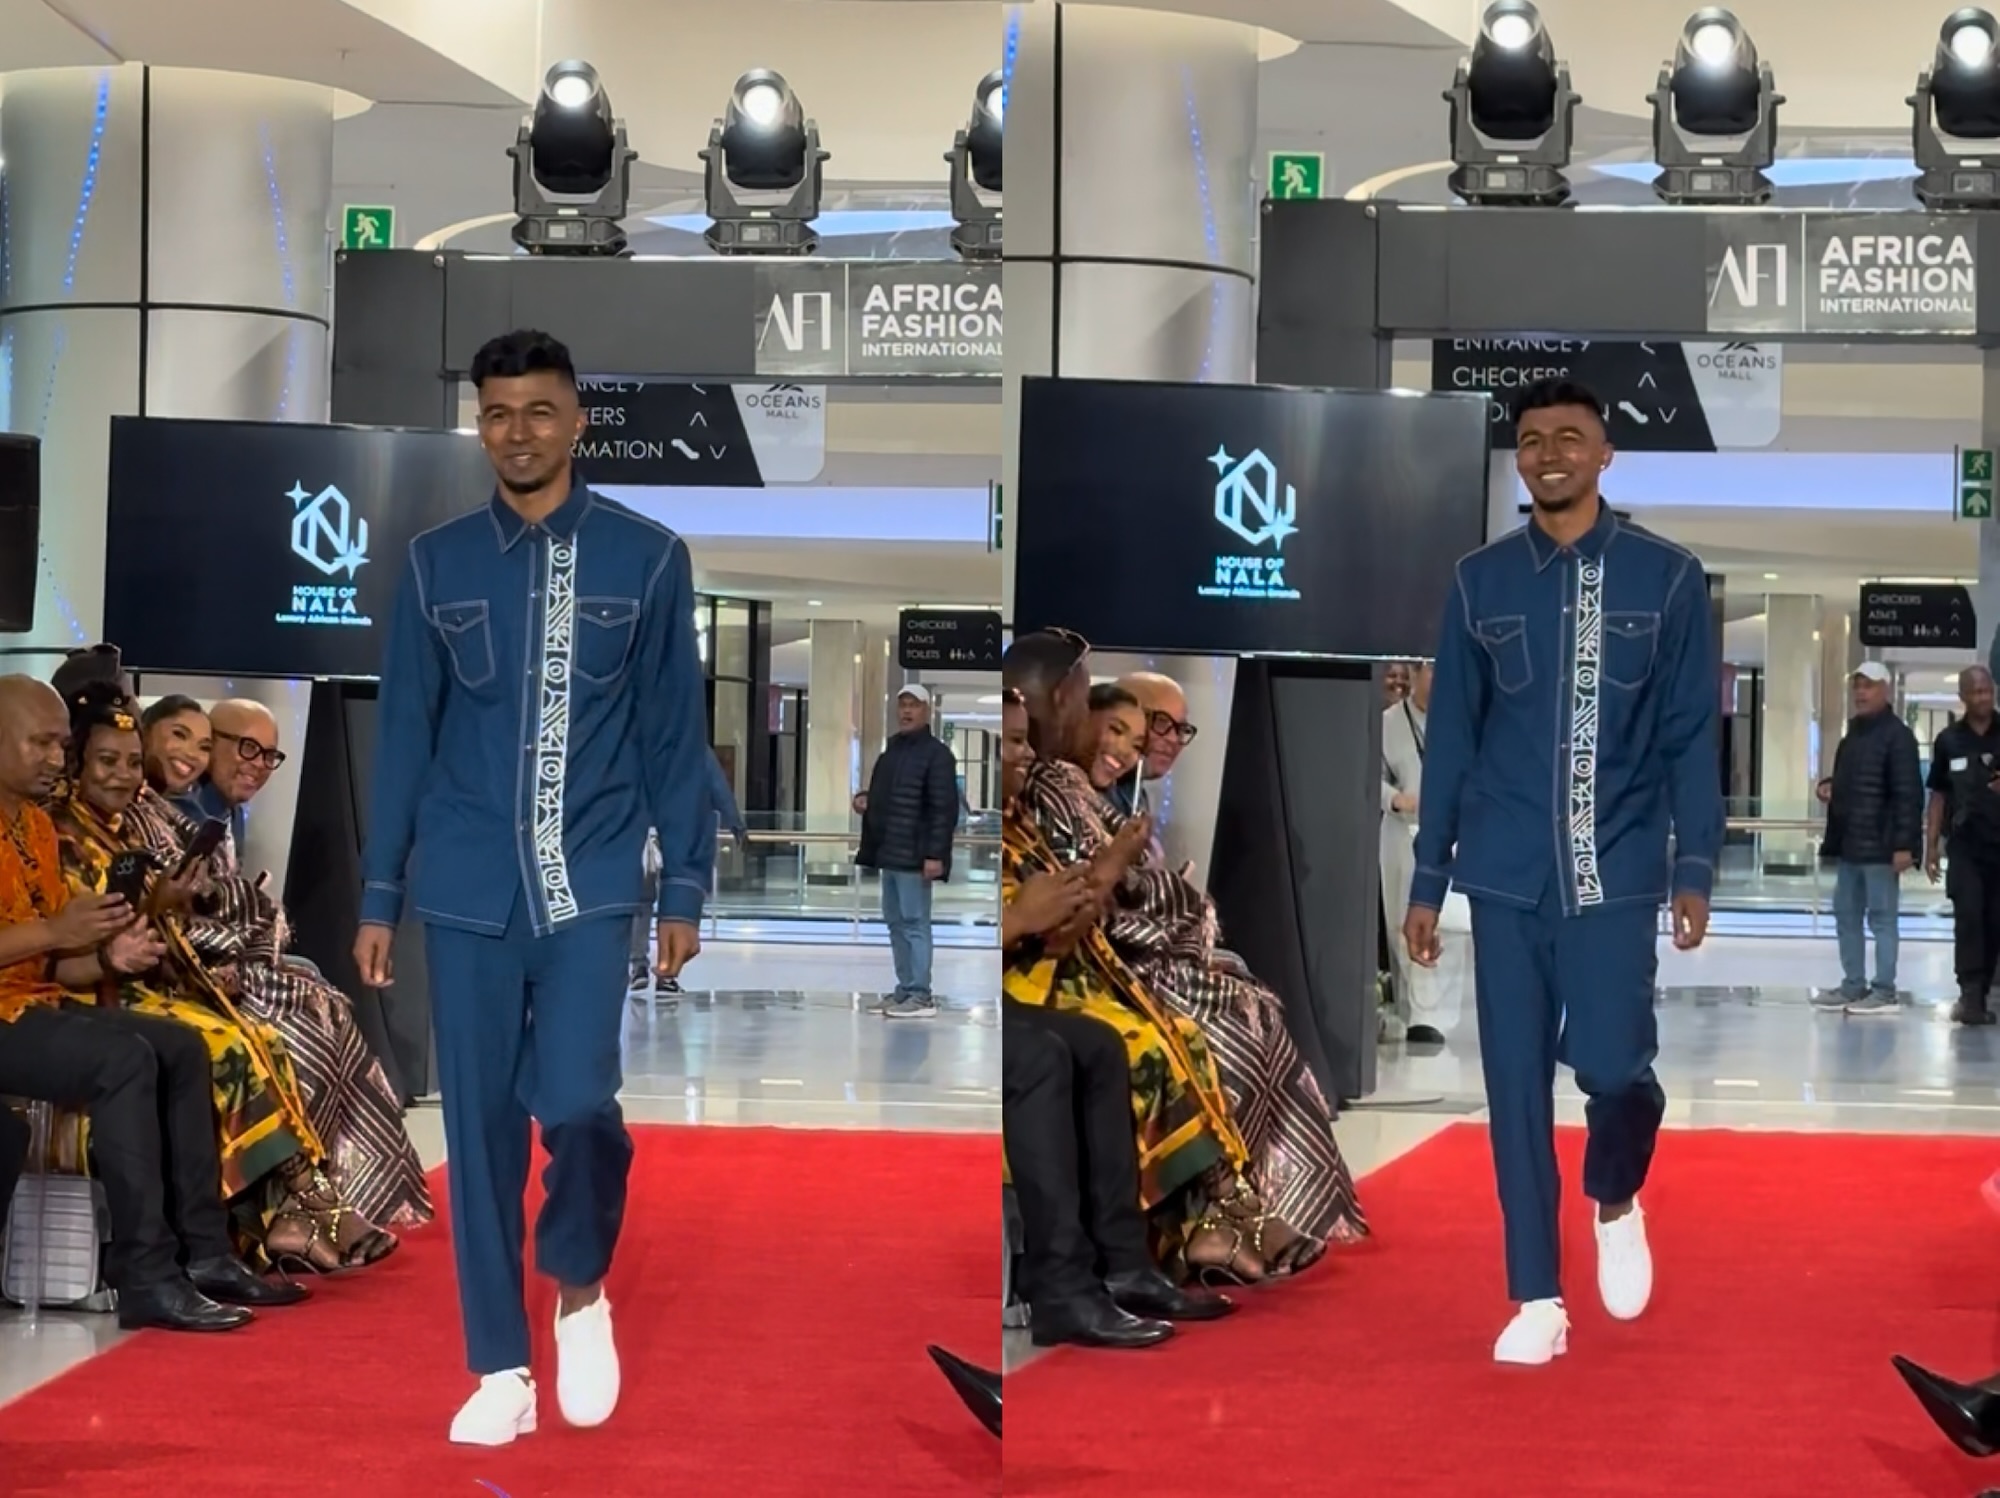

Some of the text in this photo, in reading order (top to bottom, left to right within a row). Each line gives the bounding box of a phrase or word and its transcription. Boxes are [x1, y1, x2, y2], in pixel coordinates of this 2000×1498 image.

[1820, 235, 1974, 265] AFRICA
[1820, 267, 1974, 293] FASHION
[862, 284, 1003, 312] AFRICA
[1820, 297, 1973, 313] INTERNATIONAL
[862, 314, 1003, 338] FASHION
[862, 342, 1003, 357] INTERNATIONAL
[1697, 354, 1777, 369] OCEANS
[1718, 370, 1753, 381] MALL
[745, 394, 821, 409] OCEANS
[586, 406, 627, 426] ERS
[766, 410, 799, 420] MALL
[1216, 556, 1285, 570] HOUSE OF
[1215, 568, 1285, 587] NALA
[293, 585, 357, 598] HOUSE OF
[1868, 593, 1922, 605] CHECKERS
[292, 597, 357, 614] NALA
[906, 620, 958, 630] CHECKERS
